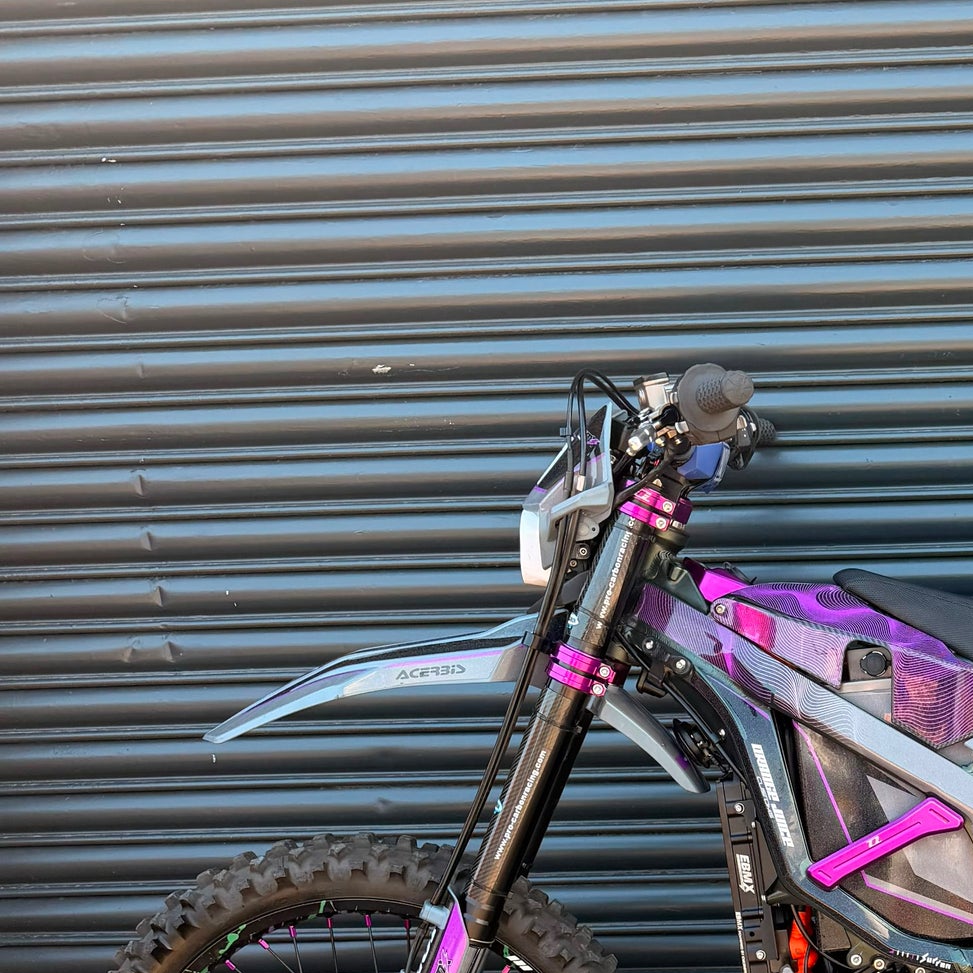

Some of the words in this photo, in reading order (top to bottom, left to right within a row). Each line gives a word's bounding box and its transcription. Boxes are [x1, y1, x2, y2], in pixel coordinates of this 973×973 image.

[395, 664, 466, 681] ACERBIS
[494, 749, 547, 860] www.pro-carbonracing.com
[735, 853, 756, 895] EBMX
